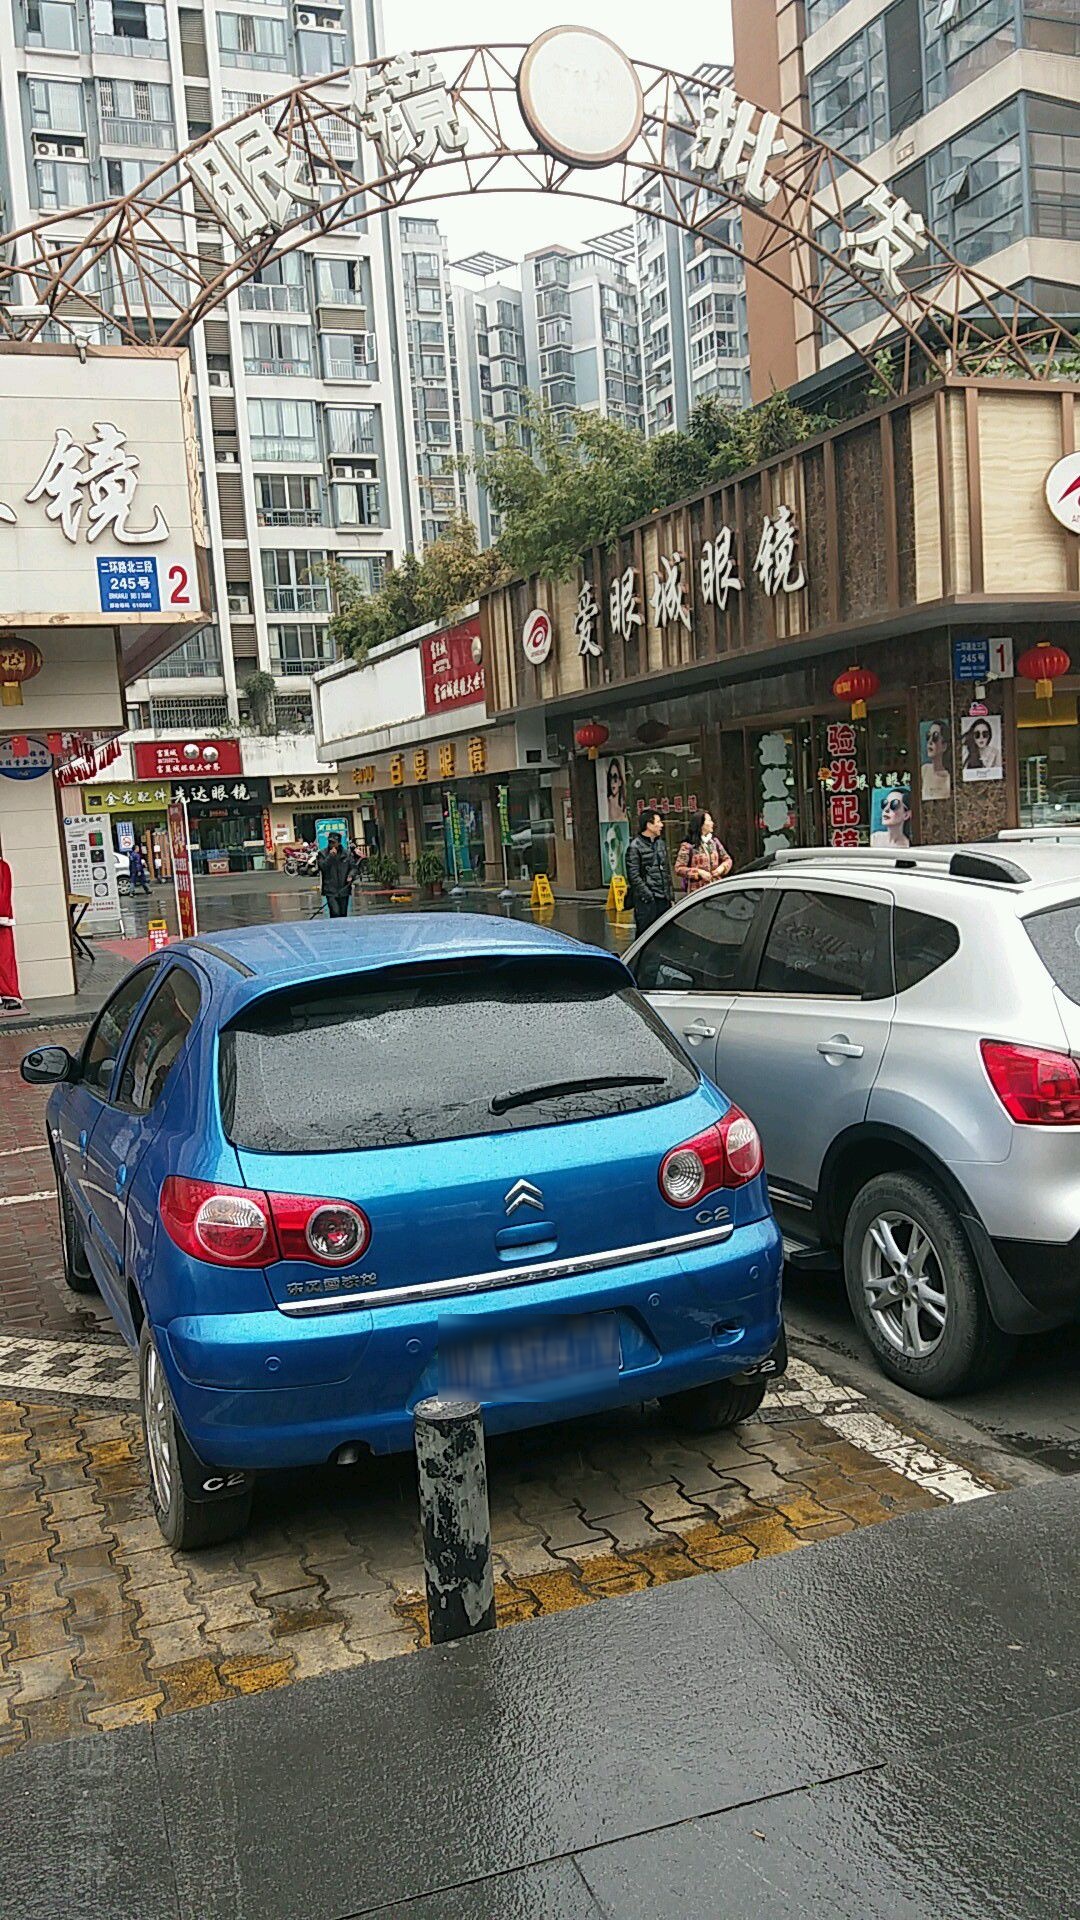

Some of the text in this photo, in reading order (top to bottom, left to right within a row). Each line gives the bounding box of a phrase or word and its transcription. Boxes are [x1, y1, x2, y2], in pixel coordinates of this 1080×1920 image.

[184, 51, 929, 297] 眼镜 批发
[0, 422, 170, 545] 镜
[101, 560, 154, 574] 二环路北三段
[110, 576, 151, 590] 245号
[168, 565, 190, 603] 2
[574, 505, 805, 656] 爱眼城眼镜
[960, 653, 985, 663] 245号
[996, 644, 1005, 672] 1
[105, 787, 167, 806] 金龙配件
[170, 783, 251, 804] 先达眼镜
[696, 1206, 730, 1223] C2
[287, 1272, 377, 1296] 东风雪铁龙
[203, 1472, 245, 1491] C2
